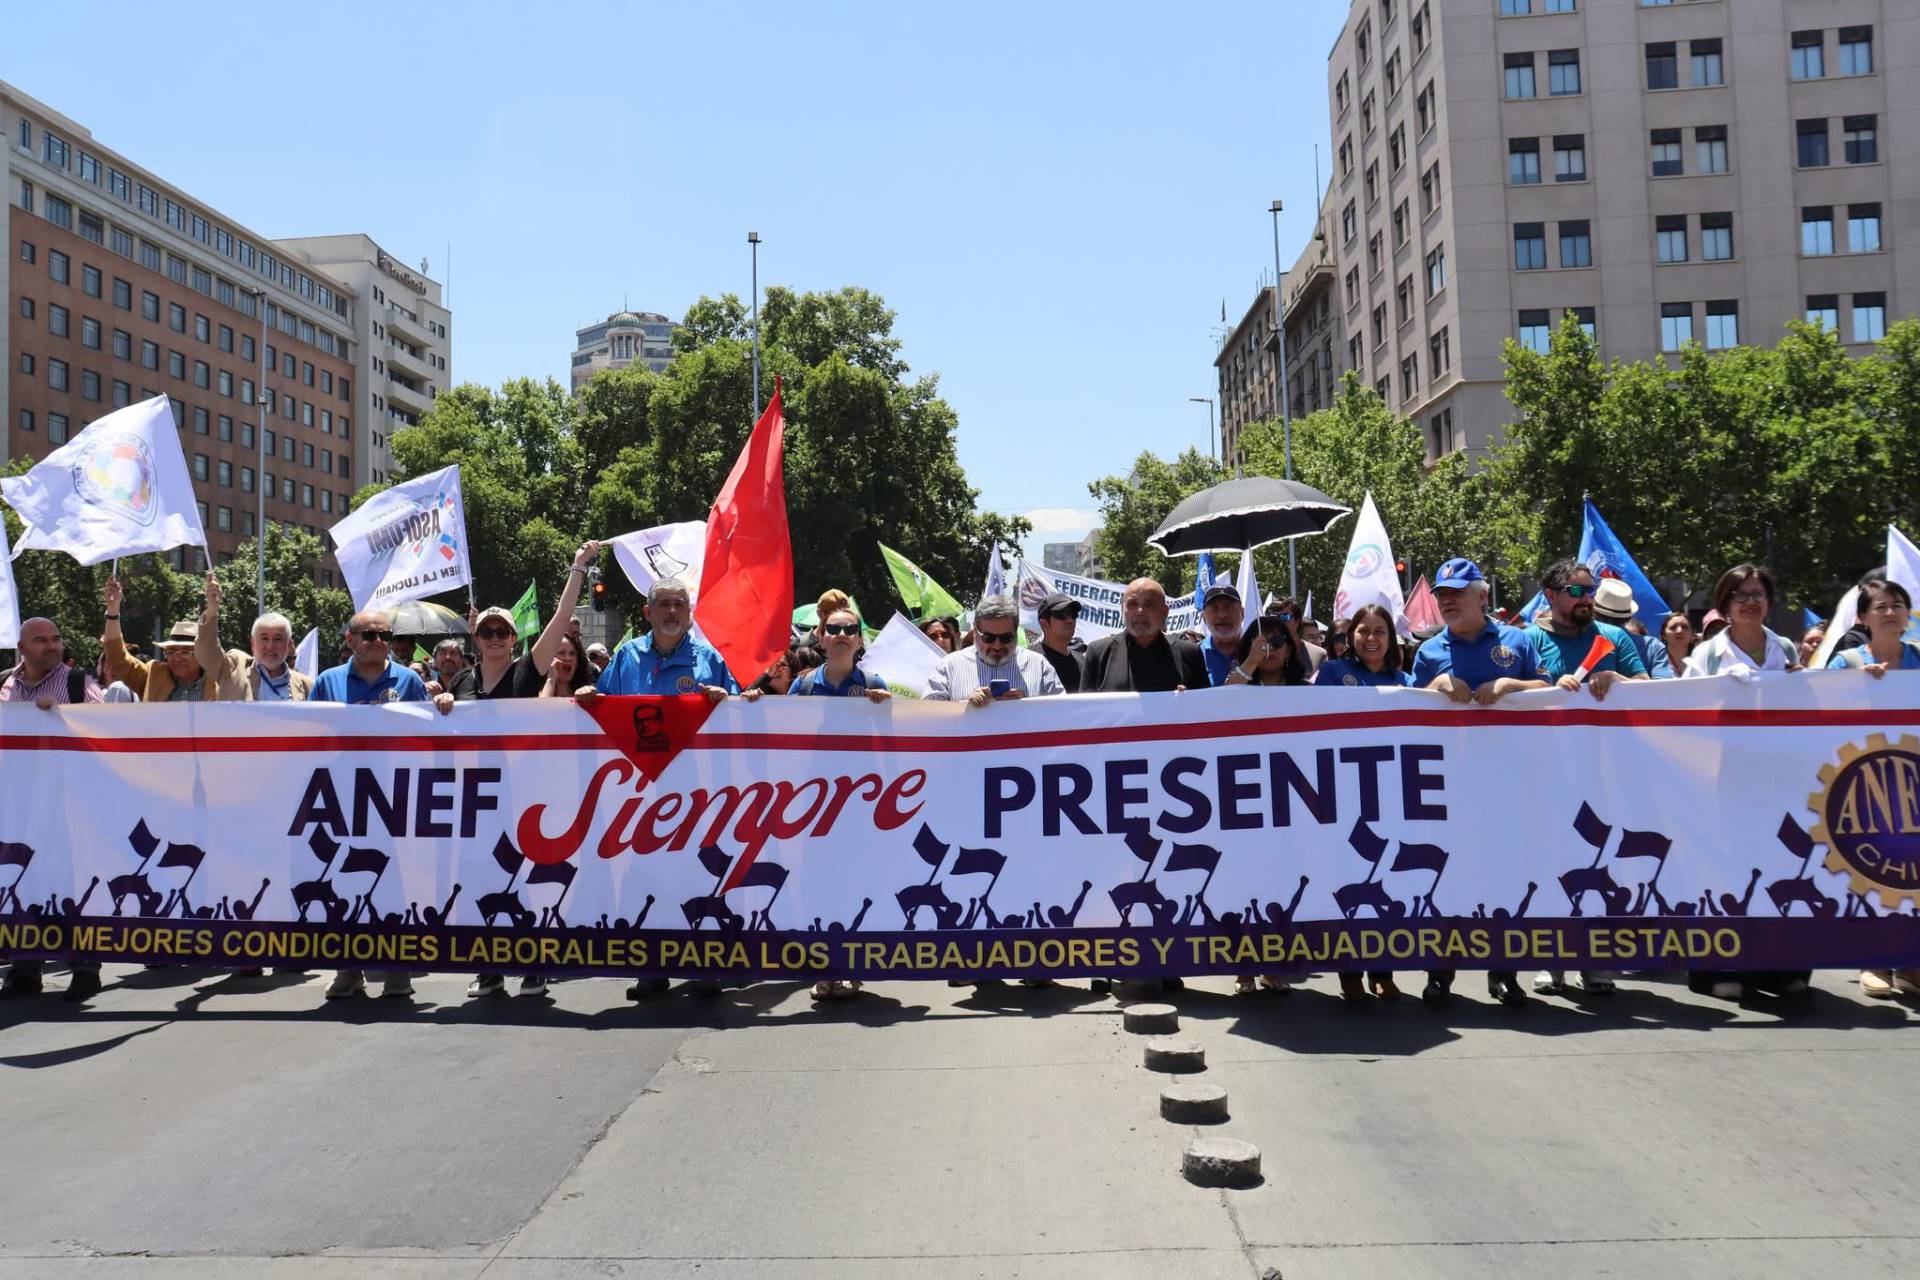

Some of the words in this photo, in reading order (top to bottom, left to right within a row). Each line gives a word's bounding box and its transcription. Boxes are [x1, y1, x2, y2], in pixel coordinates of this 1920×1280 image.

[288, 768, 502, 838] ANEF
[517, 758, 927, 896] Siempre
[985, 745, 1447, 838] PRESENTE
[72, 926, 212, 955] MEJORES
[223, 930, 439, 961] CONDICIONES
[450, 937, 647, 966] LABORALES
[660, 940, 750, 968] PARA
[761, 943, 829, 969] LOS
[843, 938, 1140, 969] TRABAJADORES
[1152, 939, 1173, 964] Y
[1183, 929, 1491, 963] TRABAJADORAS
[1503, 929, 1577, 958] DEL
[1589, 928, 1742, 958] ESTADO
